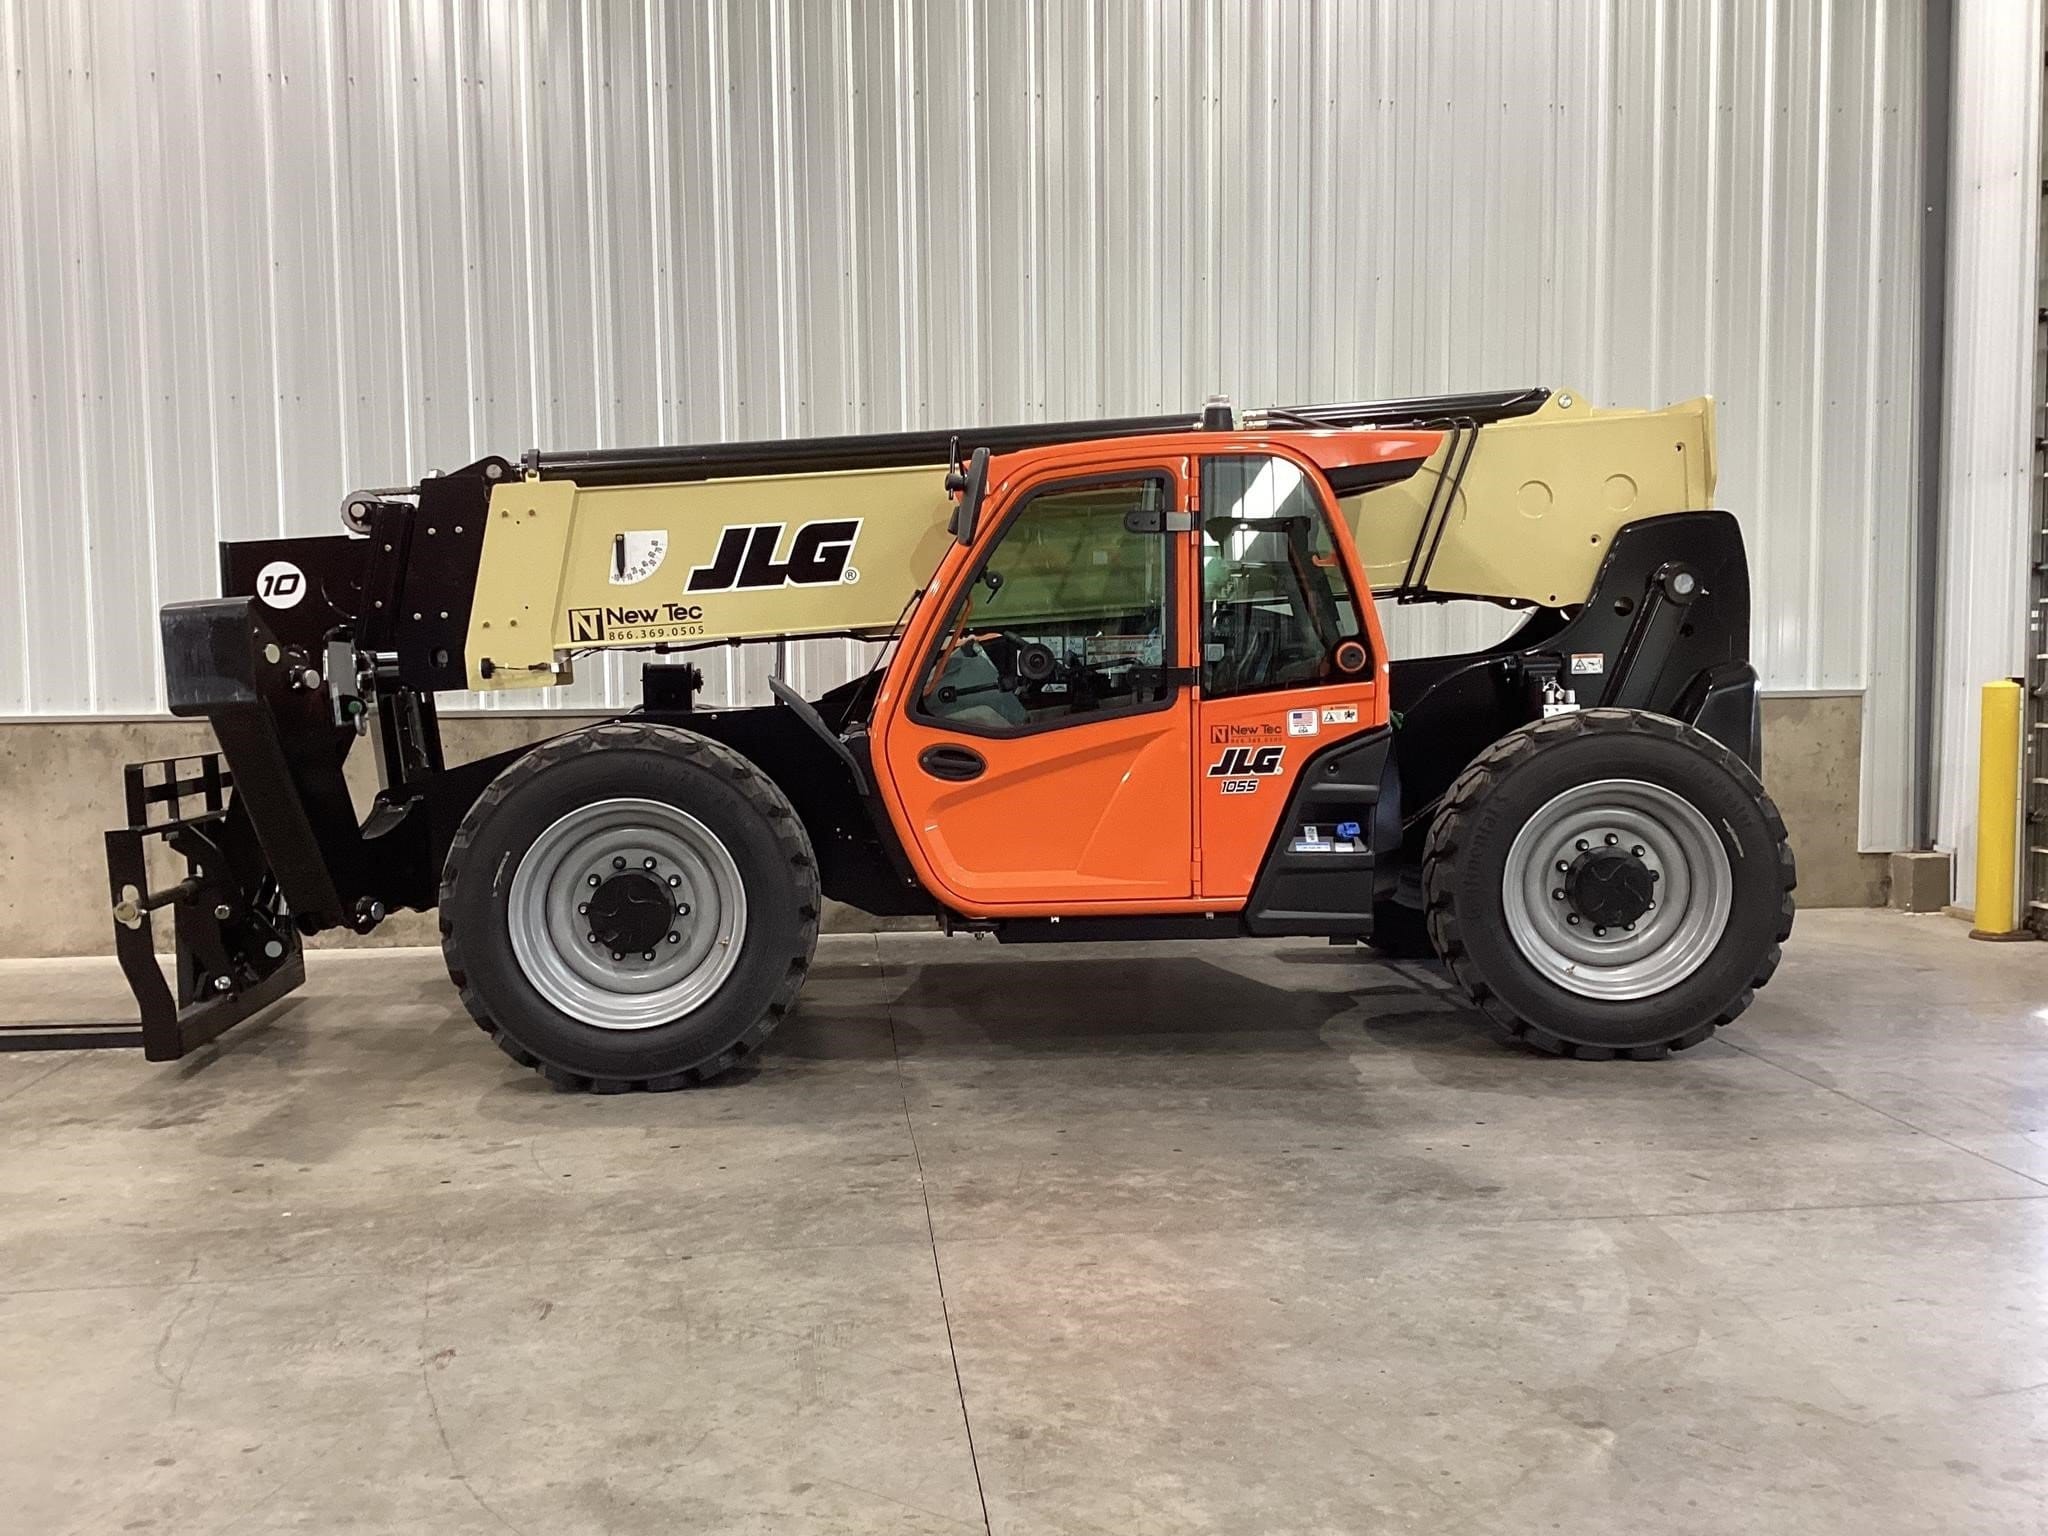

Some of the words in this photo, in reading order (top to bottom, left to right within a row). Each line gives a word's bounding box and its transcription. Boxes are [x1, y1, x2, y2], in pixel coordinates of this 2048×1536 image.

[686, 519, 861, 593] JLG
[263, 573, 300, 597] 10
[606, 606, 658, 625] New
[662, 603, 703, 621] Tec
[609, 625, 704, 640] 866.369.0505
[1230, 725, 1258, 735] New
[1261, 724, 1282, 734] Tec
[1209, 747, 1284, 776] JLG
[1221, 780, 1258, 793] 1055
